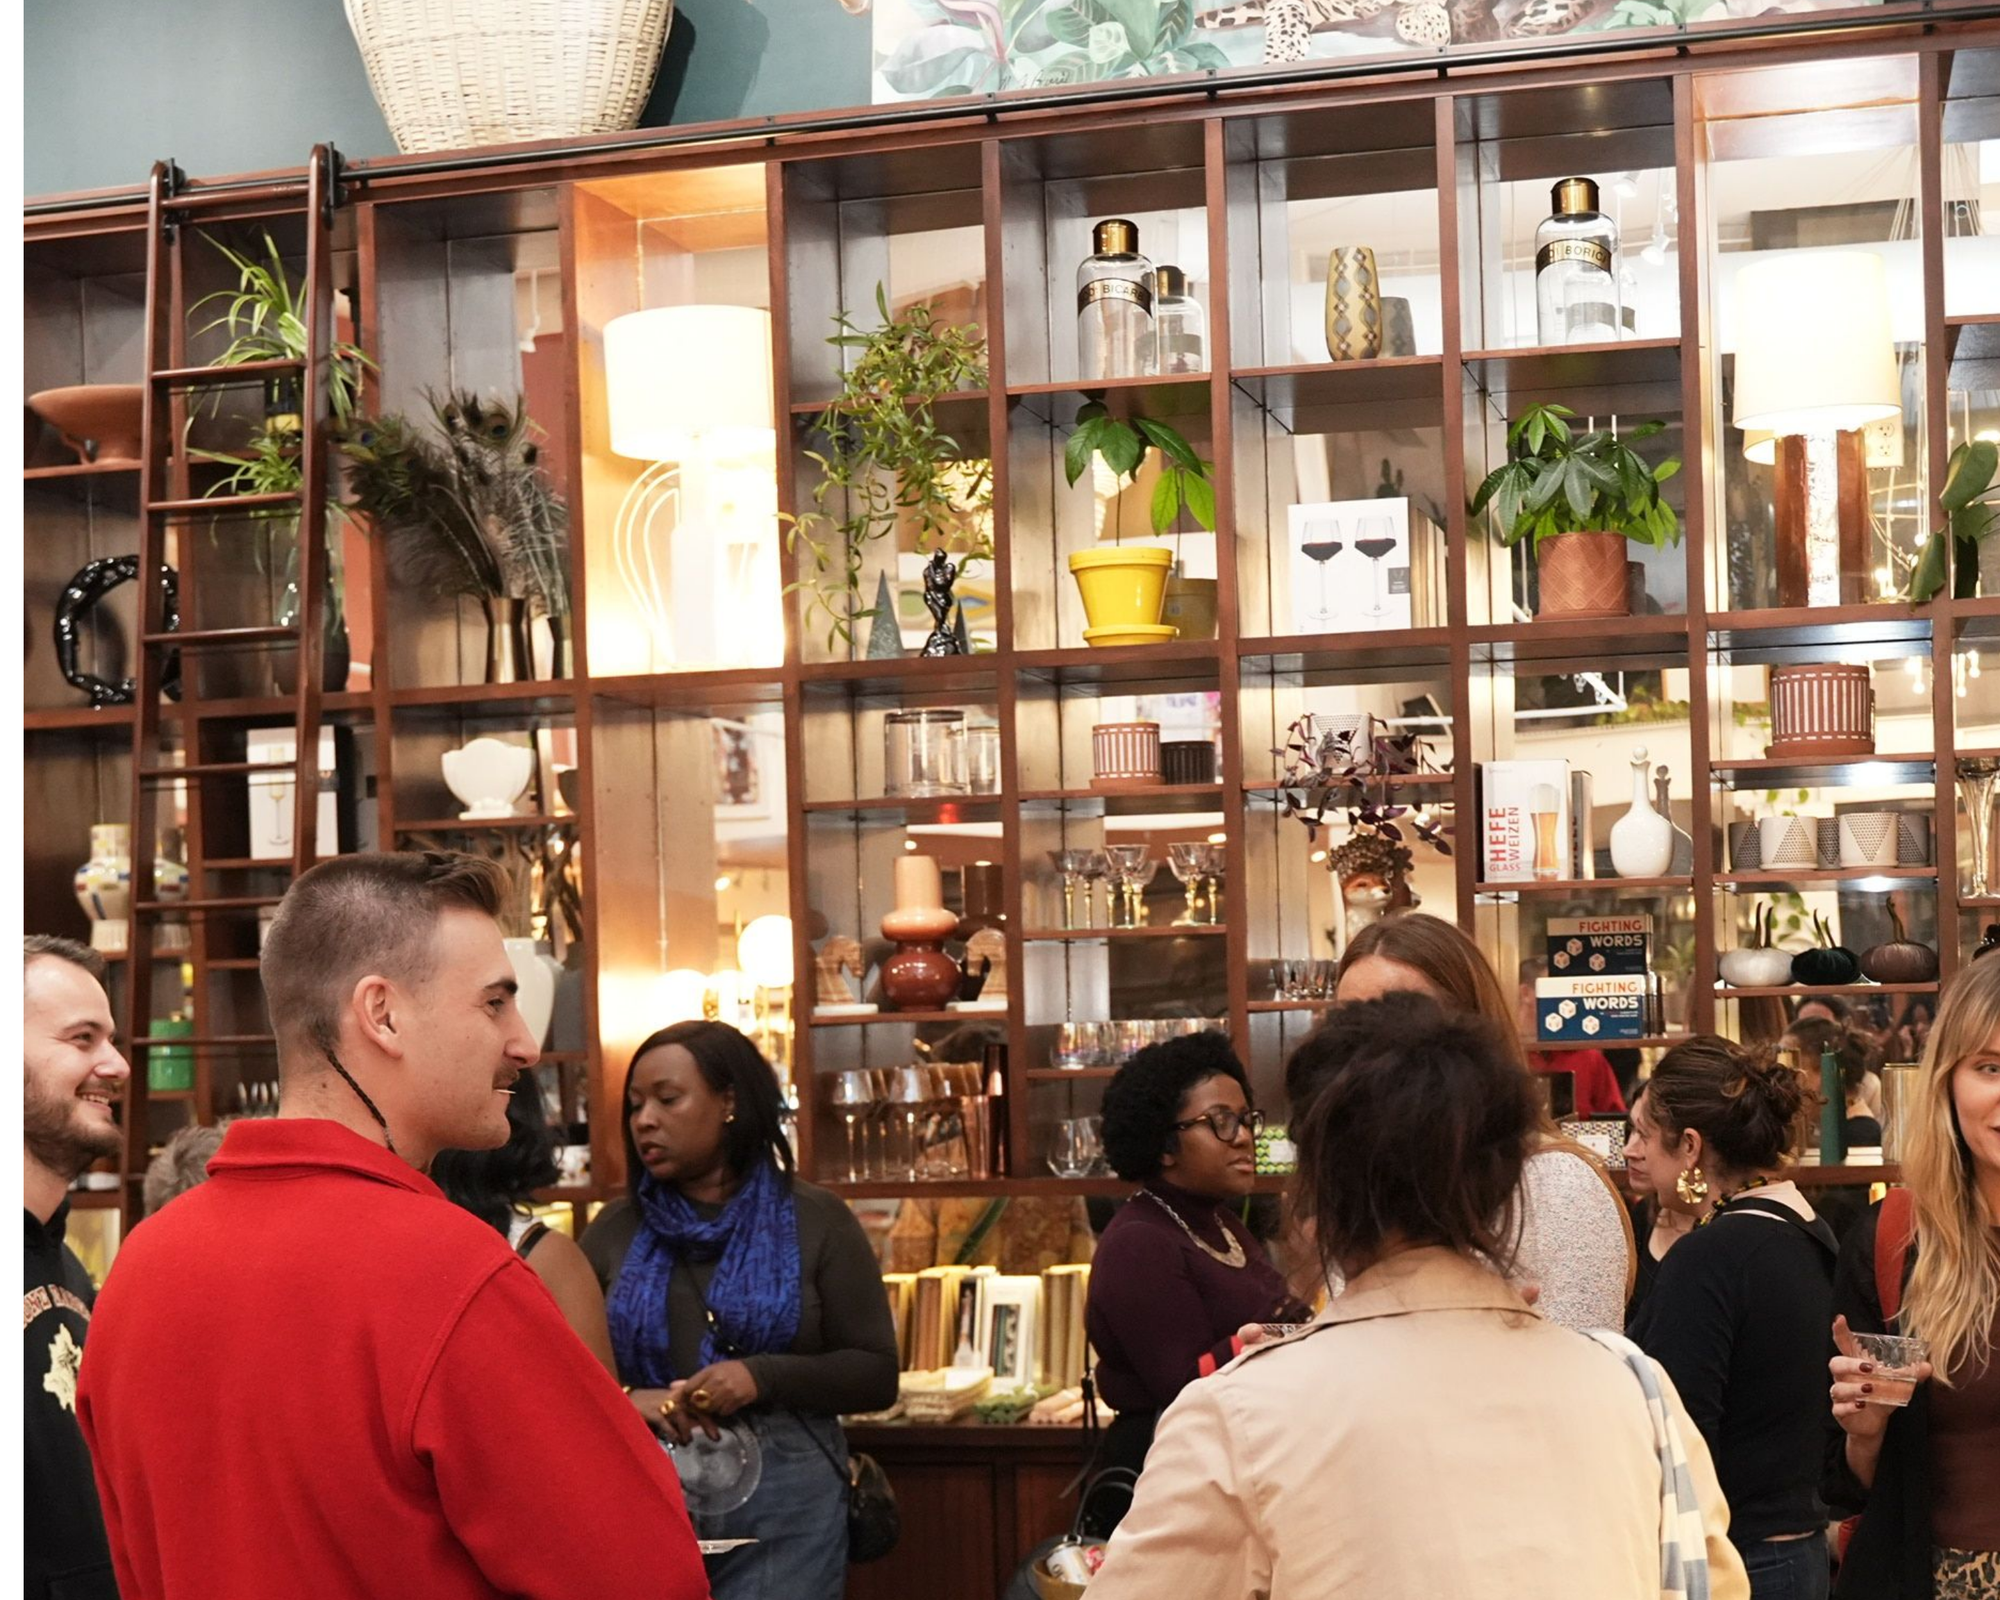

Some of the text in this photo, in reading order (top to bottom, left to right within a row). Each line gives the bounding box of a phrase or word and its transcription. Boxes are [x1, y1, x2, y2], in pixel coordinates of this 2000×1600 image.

[1488, 807, 1506, 862] HEFE
[1508, 806, 1520, 862] WEIZEN
[1488, 863, 1521, 872] GLASS
[1579, 919, 1642, 933] FIGHTING
[1590, 934, 1643, 947] WORDS
[1572, 981, 1638, 994] FIGHTING
[1582, 996, 1639, 1010] WORDS
